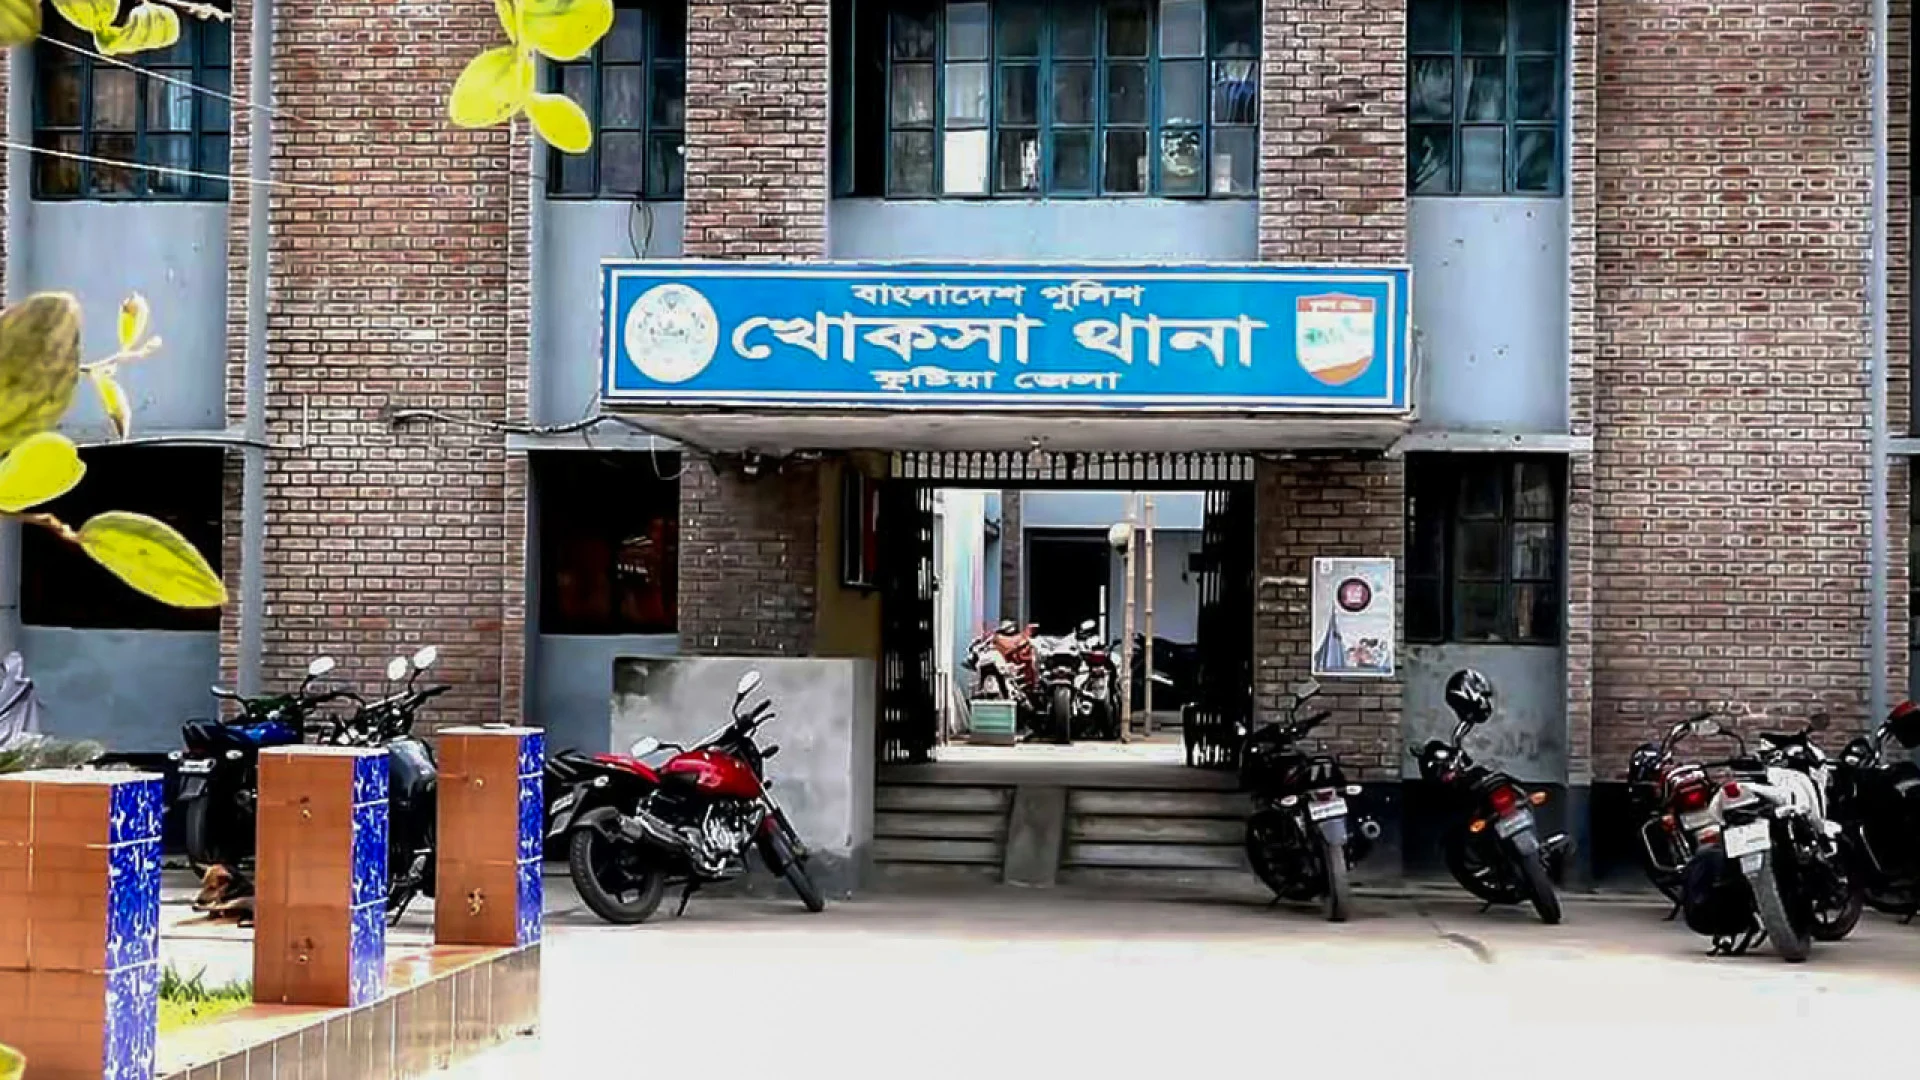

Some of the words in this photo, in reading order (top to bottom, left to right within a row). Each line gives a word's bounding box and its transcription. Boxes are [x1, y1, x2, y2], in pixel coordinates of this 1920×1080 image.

[851, 283, 1026, 307] বাংলাদেশ
[1040, 279, 1146, 311] পুলিশ
[731, 311, 1045, 364] খোকসা
[1073, 312, 1269, 367] থানা
[1014, 371, 1122, 390] জেলা
